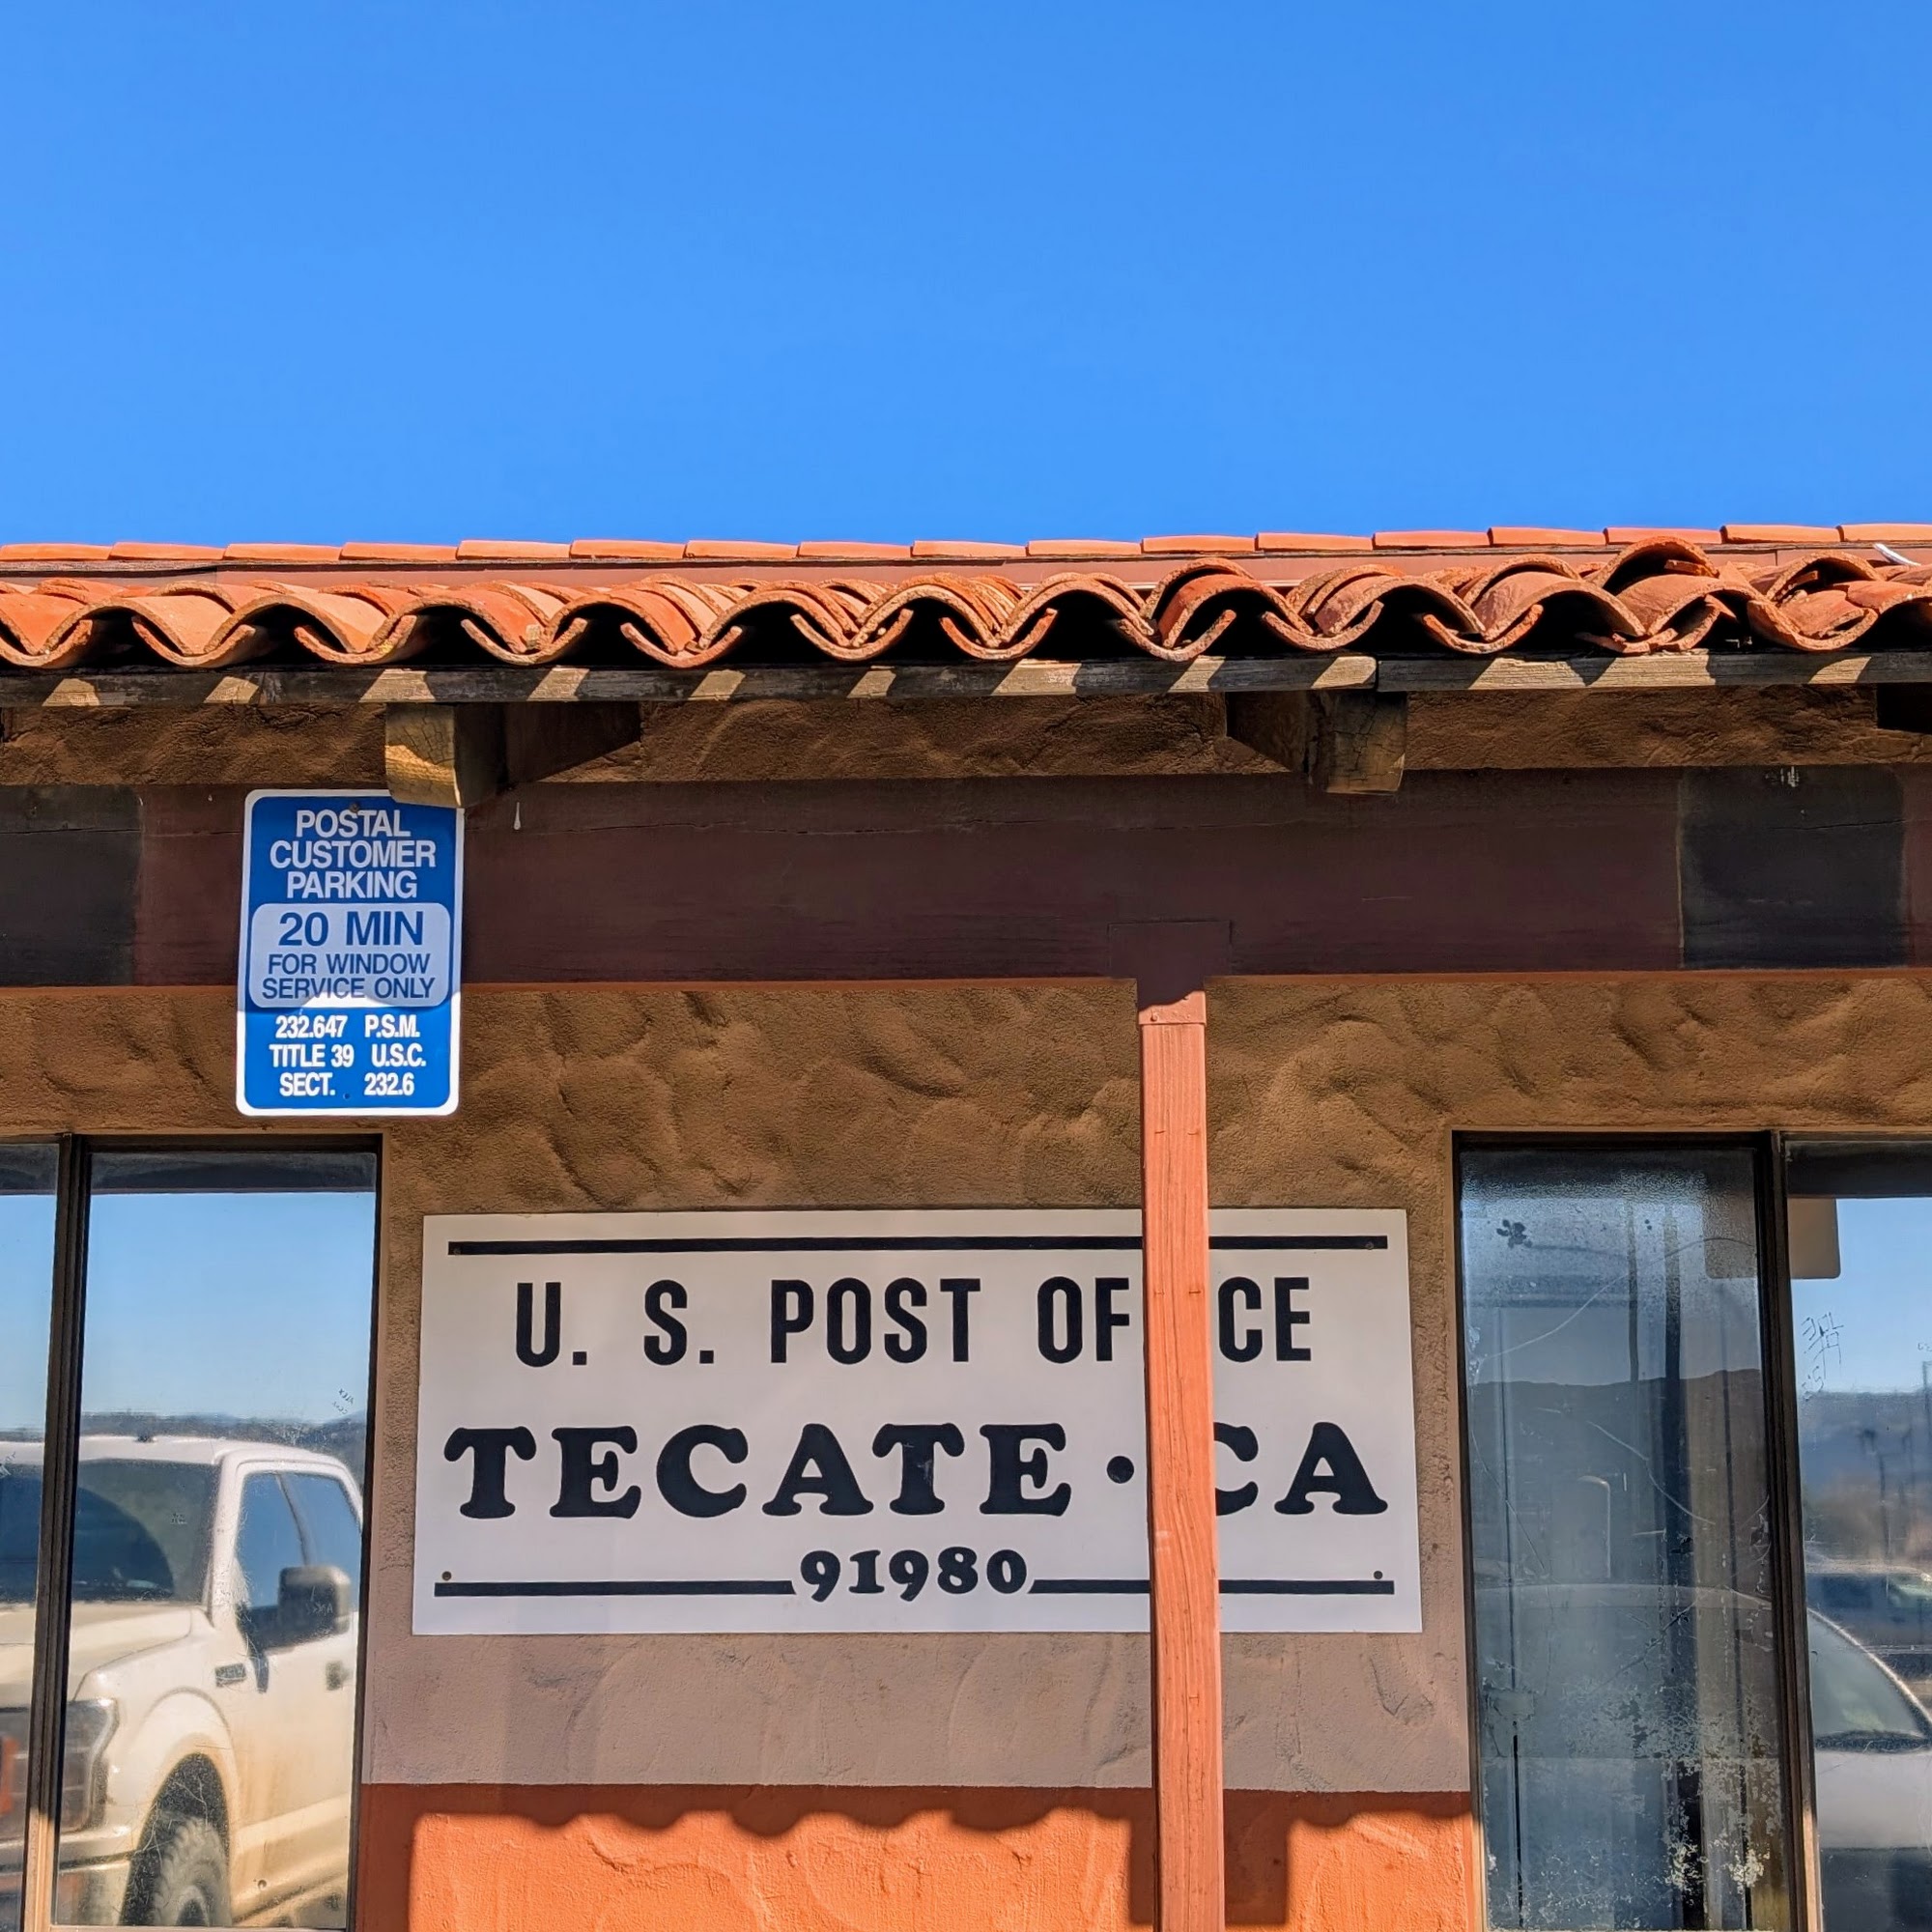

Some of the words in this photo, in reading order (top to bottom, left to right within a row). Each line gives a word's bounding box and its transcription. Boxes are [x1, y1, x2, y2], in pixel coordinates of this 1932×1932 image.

[296, 810, 411, 838] POSTAL
[270, 840, 436, 868] CUSTOMER
[286, 870, 417, 899] PARKING
[278, 912, 329, 947] 20
[346, 911, 423, 946] MIN
[268, 953, 316, 975] FOR
[326, 953, 431, 974] WINDOW
[262, 978, 365, 999] SERVICE
[374, 977, 436, 999] ONLY
[275, 1015, 348, 1038] 232.647
[269, 1044, 326, 1067] TITLE
[330, 1044, 354, 1067] 39
[279, 1072, 335, 1096] SECT.
[363, 1072, 414, 1095] 232.6
[515, 1281, 587, 1368] U.
[643, 1279, 715, 1366] S.
[770, 1277, 981, 1365] POST
[1037, 1276, 1313, 1364] OFCE
[443, 1422, 1072, 1520] TECATE
[800, 1546, 1028, 1603] 91980
